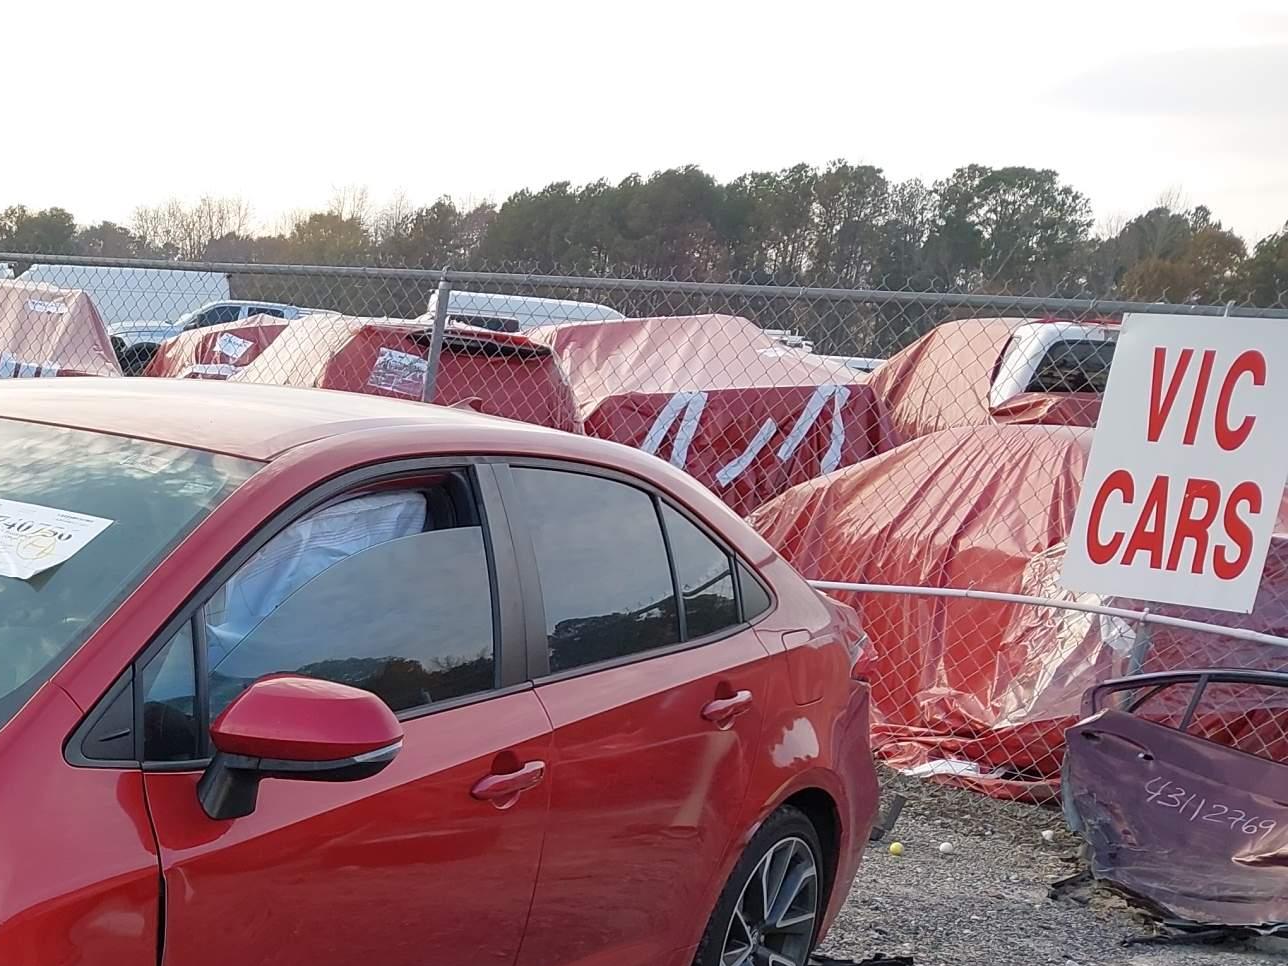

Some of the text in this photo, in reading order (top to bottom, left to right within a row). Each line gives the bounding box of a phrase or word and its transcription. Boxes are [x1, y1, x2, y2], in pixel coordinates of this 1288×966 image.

[1146, 346, 1267, 451] VIC
[1086, 469, 1262, 580] CARS
[1144, 776, 1277, 838] 43112769
